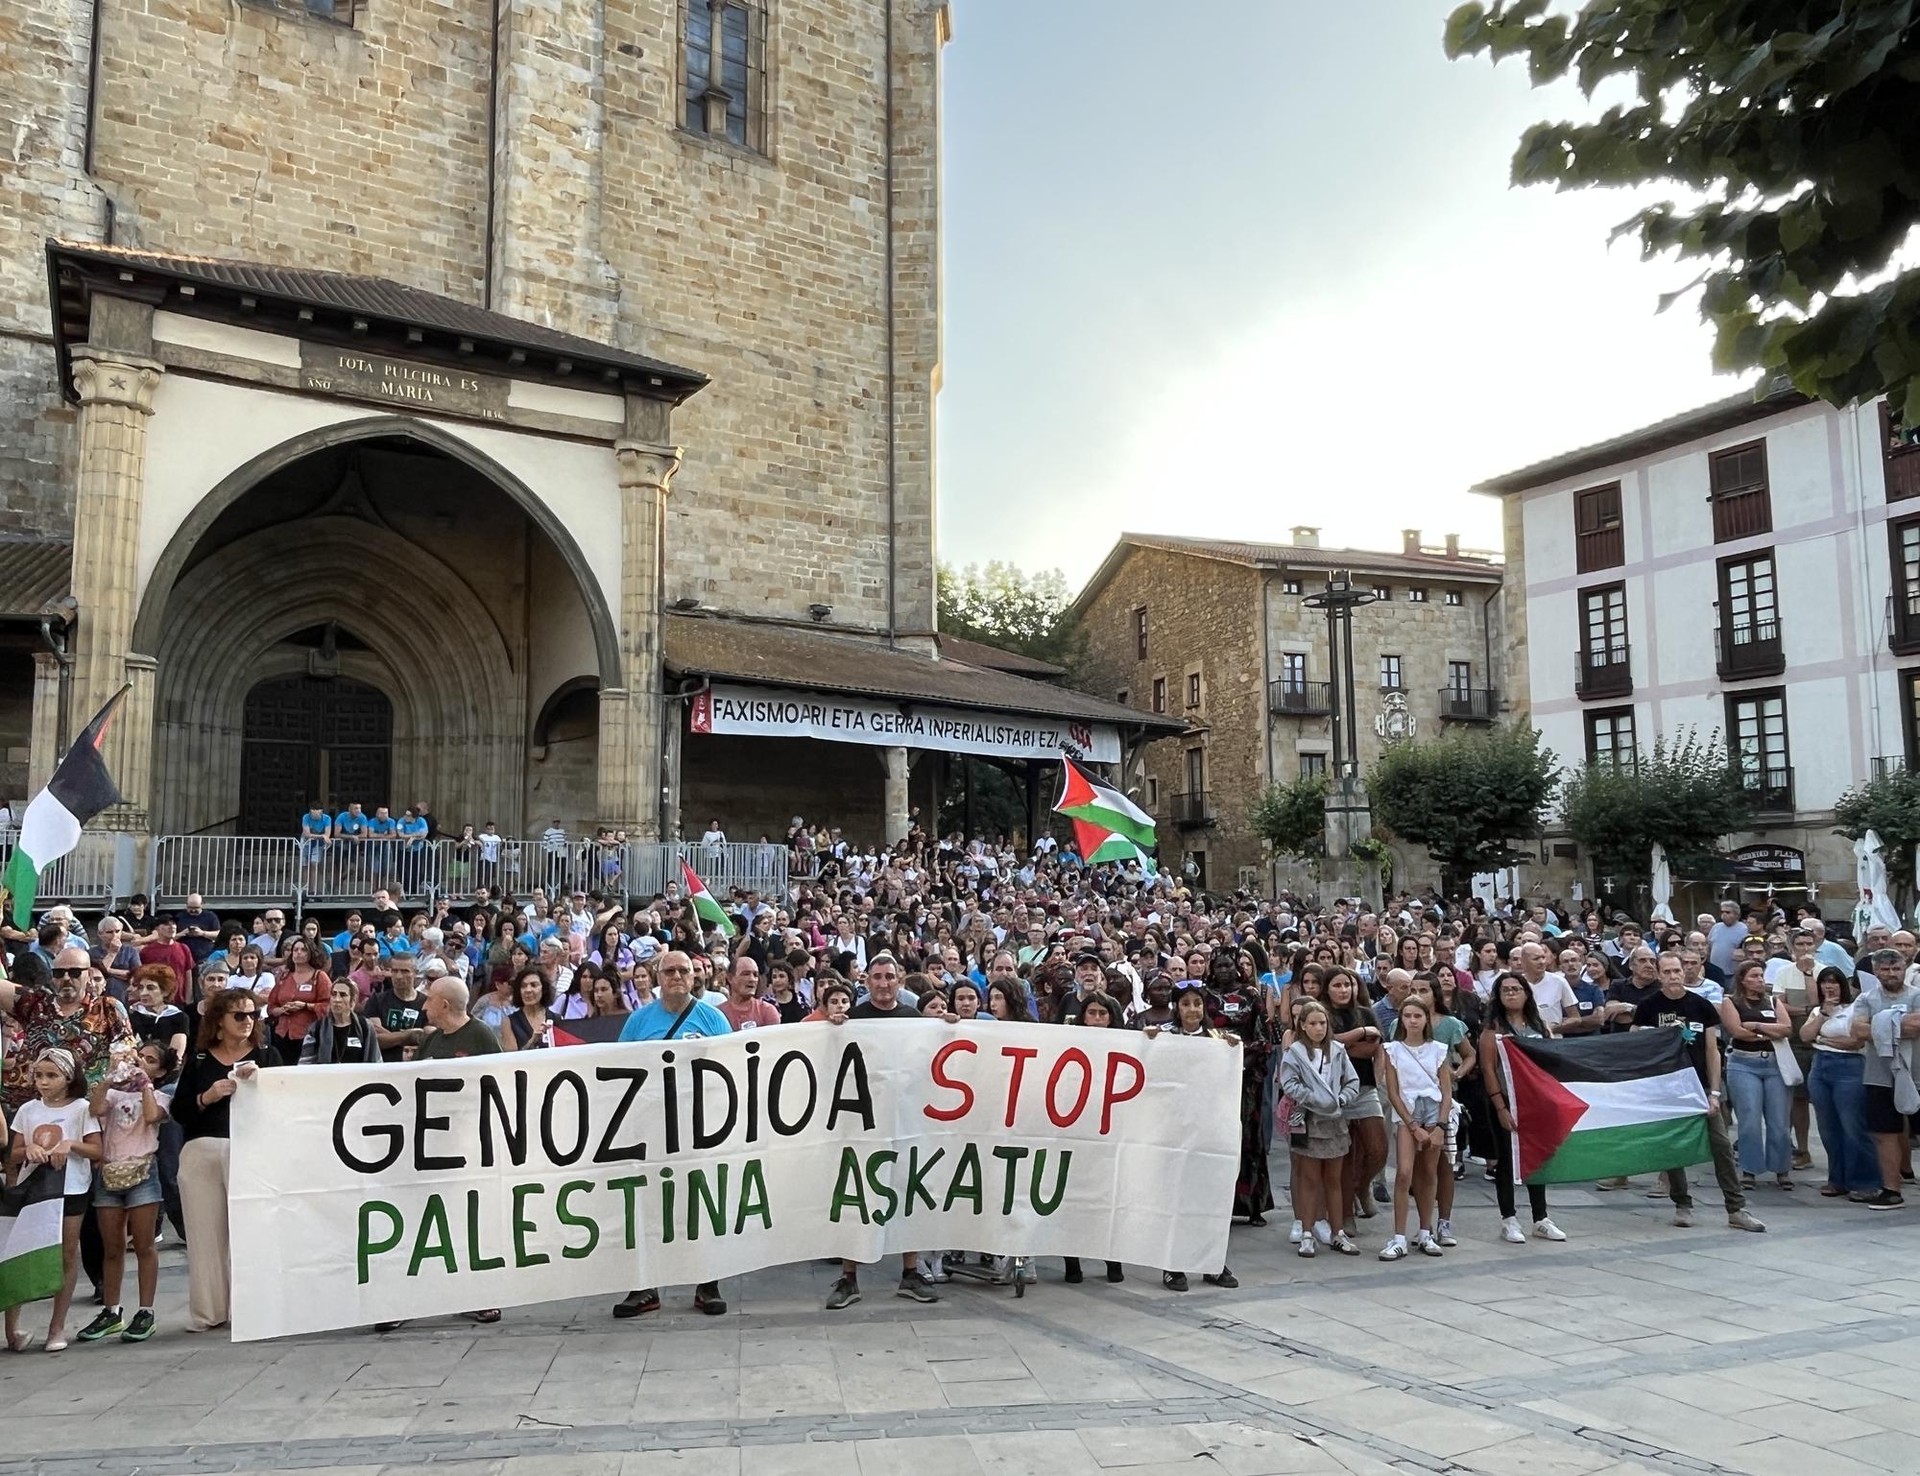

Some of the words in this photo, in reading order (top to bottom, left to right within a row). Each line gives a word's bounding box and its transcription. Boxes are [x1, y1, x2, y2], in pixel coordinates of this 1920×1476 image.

[339, 356, 374, 373] TOTA
[385, 364, 451, 386] PULCHRA
[461, 378, 479, 392] ES
[713, 698, 826, 727] FAXISMOARI
[831, 708, 865, 730] ETA
[870, 712, 924, 735] GERRA
[929, 718, 1035, 747] INPERIALISTARI
[1774, 850, 1799, 859] PLAZA
[923, 1039, 1146, 1135] STOP
[829, 1142, 1073, 1227] ASKATU
